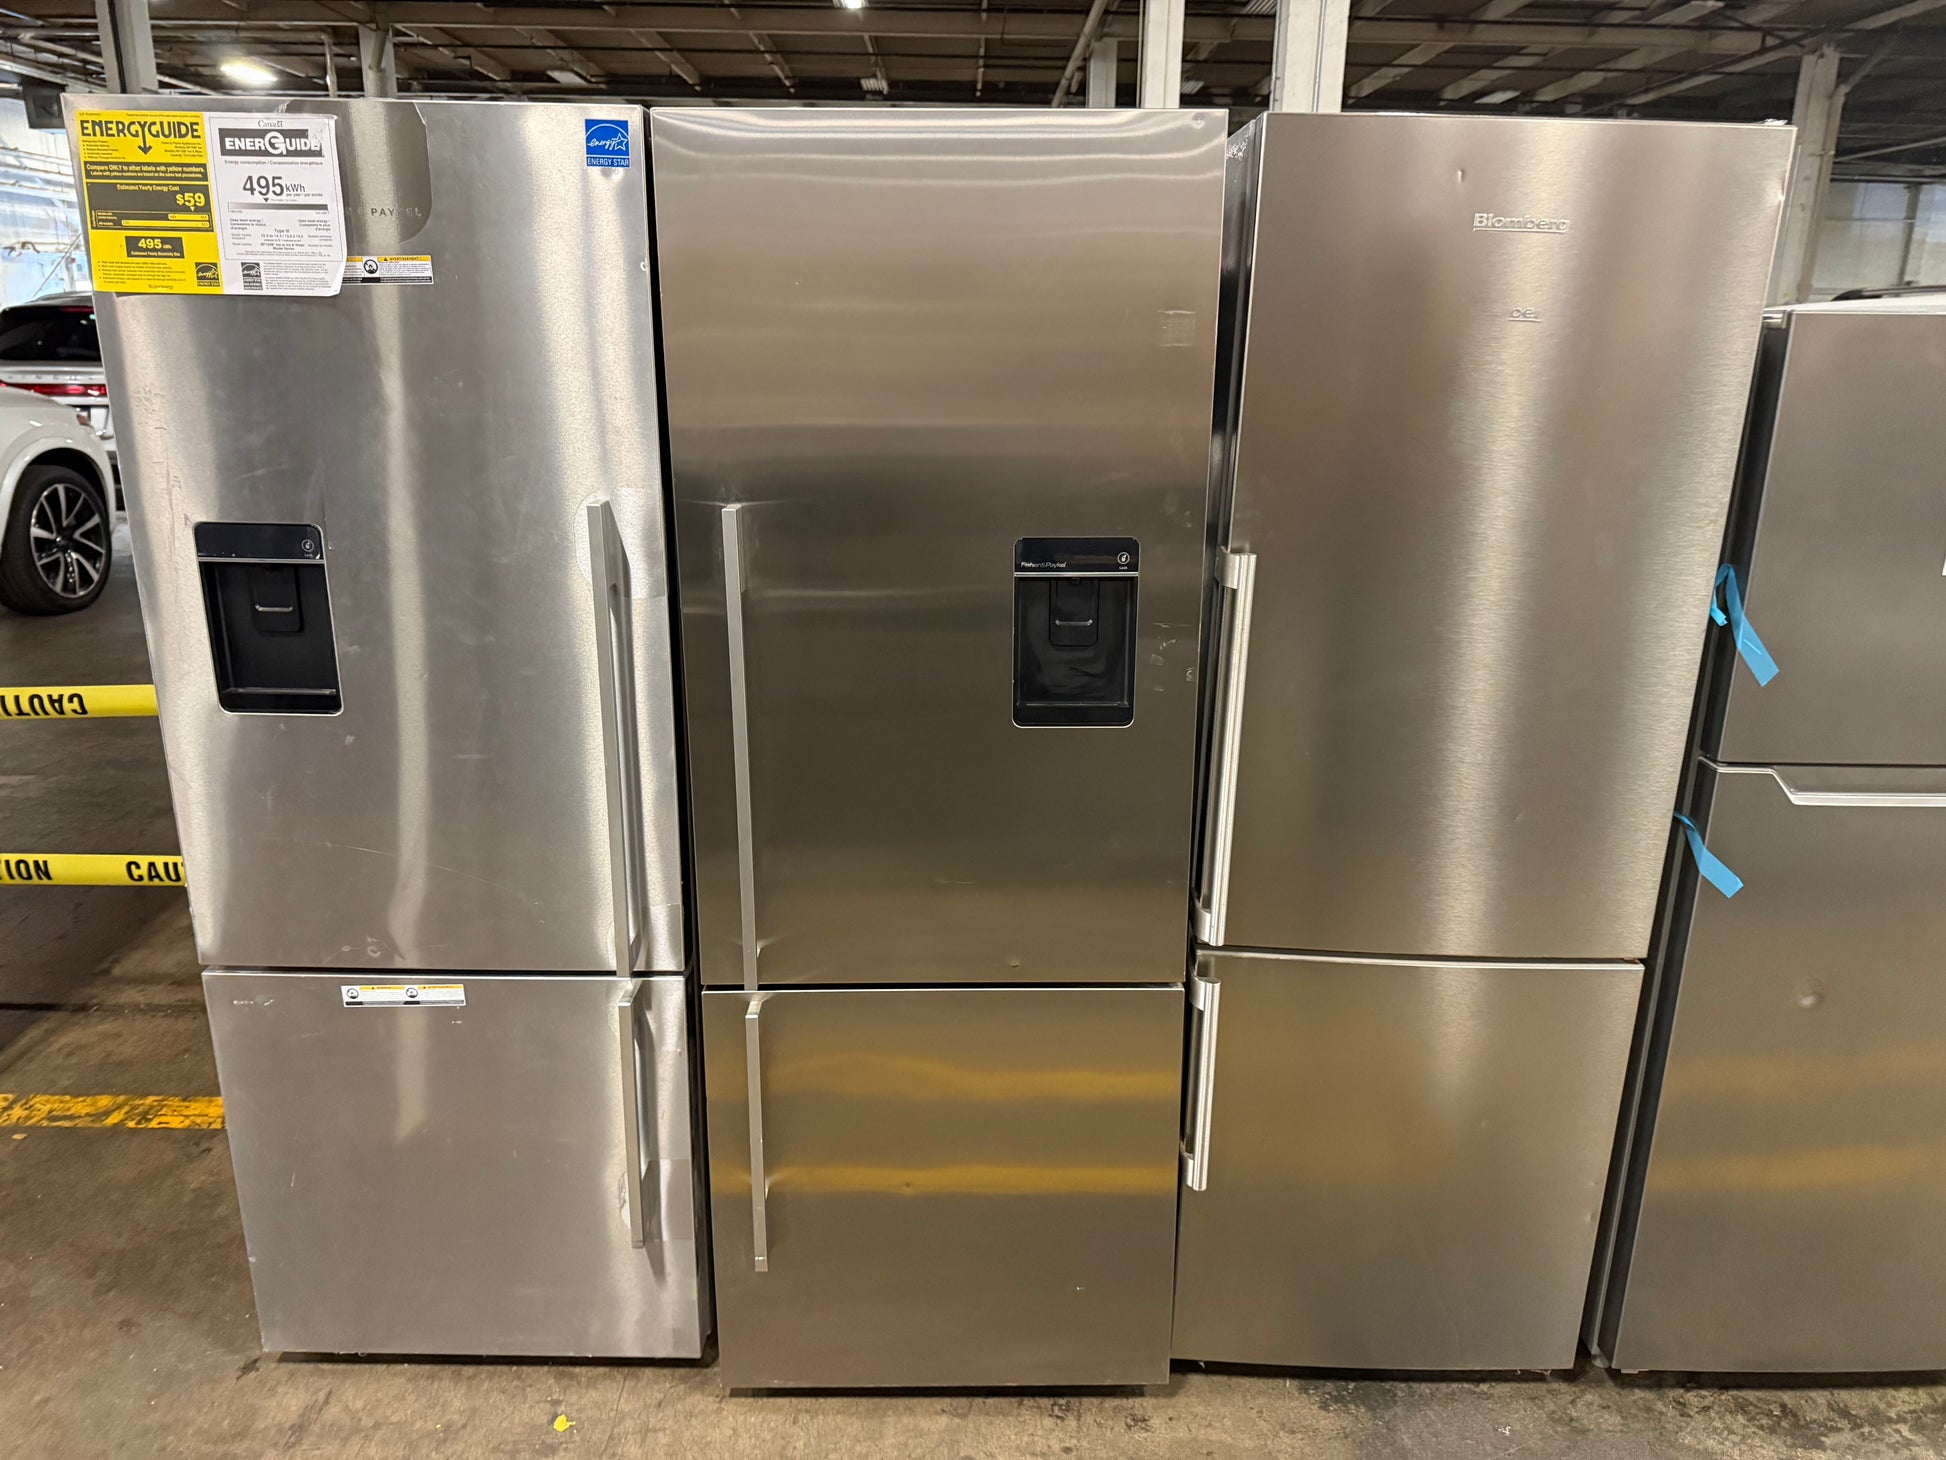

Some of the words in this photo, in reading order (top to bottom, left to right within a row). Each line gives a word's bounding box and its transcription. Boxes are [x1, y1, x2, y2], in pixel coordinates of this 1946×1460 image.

[80, 119, 202, 140] ENERGYGUIDE
[86, 163, 109, 172] Compare
[167, 165, 183, 173] yellow
[183, 165, 205, 173] numbers.
[587, 157, 612, 166] ENERGY
[613, 158, 629, 166] STAR
[116, 183, 139, 191] Estimated
[153, 184, 169, 192] Energy
[242, 175, 285, 196] 495
[285, 183, 306, 193] kWh
[176, 192, 205, 207] $59
[370, 207, 422, 217] PAYEL
[1473, 212, 1570, 231] Blomberg
[138, 238, 162, 249] 495
[0, 859, 53, 881] ION
[125, 860, 186, 882] CAU
